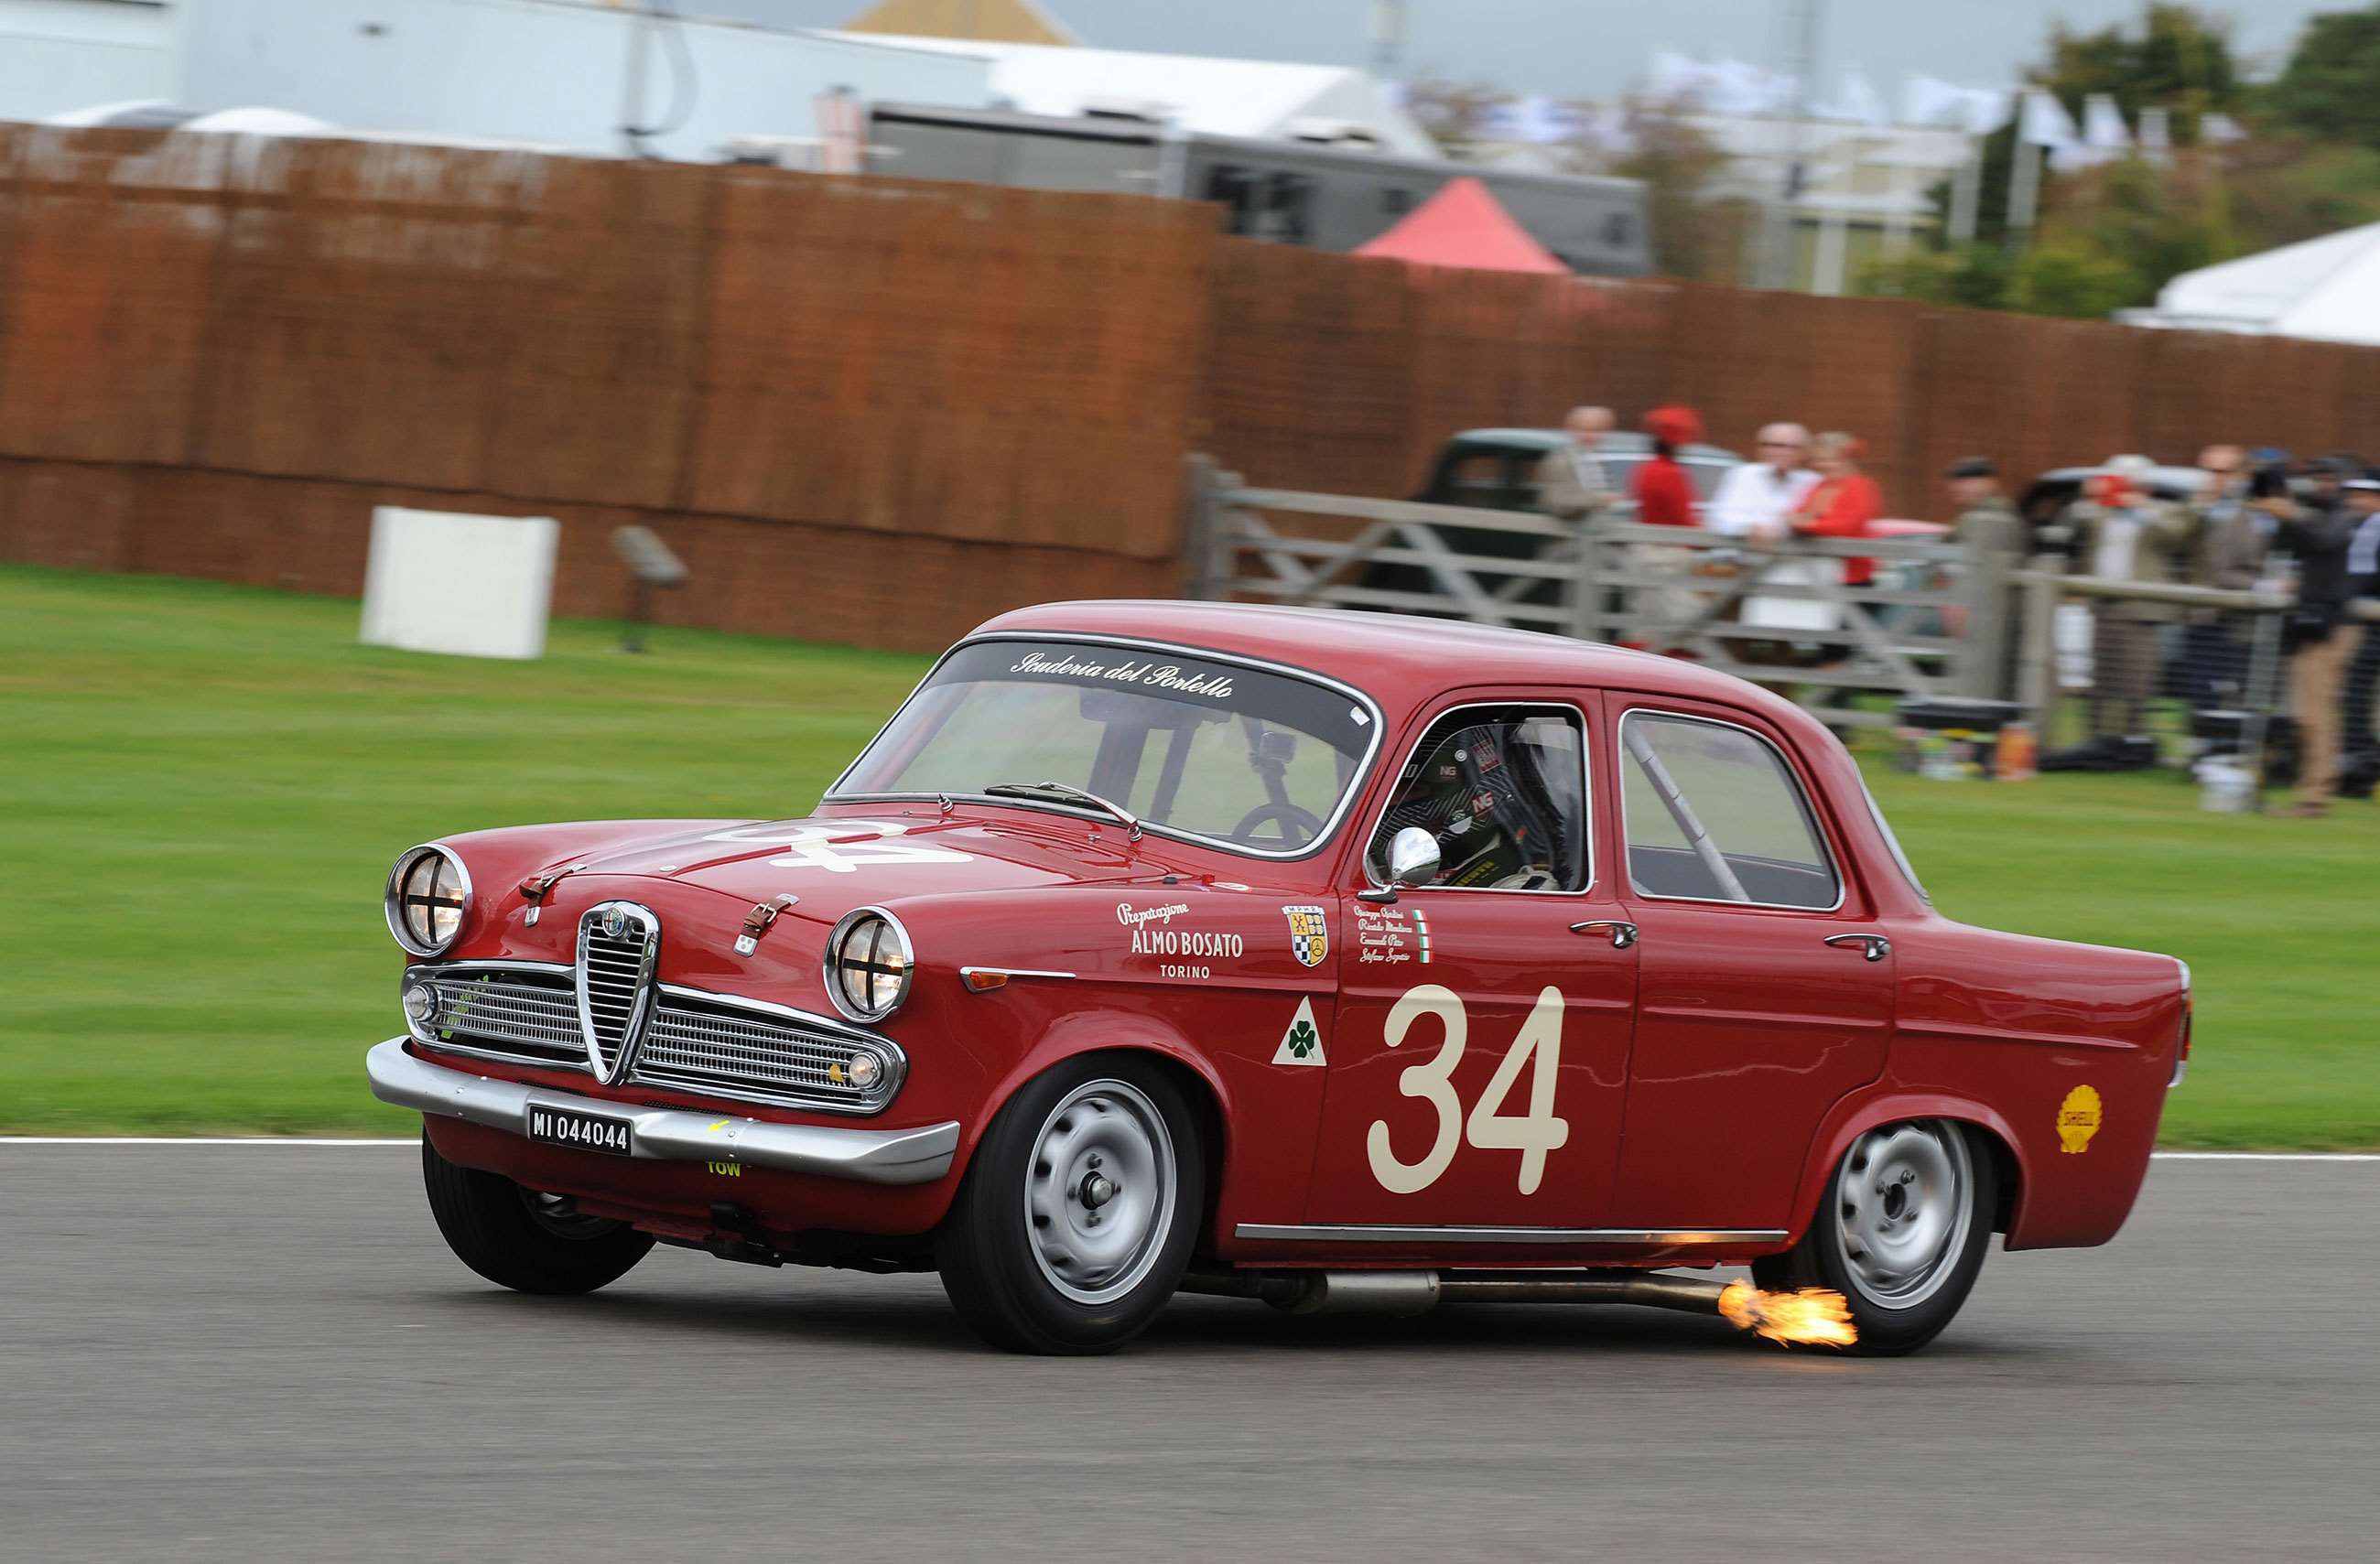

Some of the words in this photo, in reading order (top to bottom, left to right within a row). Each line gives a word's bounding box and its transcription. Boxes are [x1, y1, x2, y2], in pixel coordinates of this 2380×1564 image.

[1010, 652, 1101, 678] Scuderia
[1103, 662, 1145, 683] del
[1143, 665, 1232, 698] Portello
[1116, 902, 1189, 930] Preparazione
[1130, 930, 1178, 955] ALMO
[1180, 932, 1244, 958] BOSATO
[1160, 965, 1210, 980] TORINO
[1367, 984, 1570, 1196] 34
[533, 1111, 553, 1138] MI
[557, 1116, 628, 1150] 044044
[706, 1160, 741, 1178] TOW
